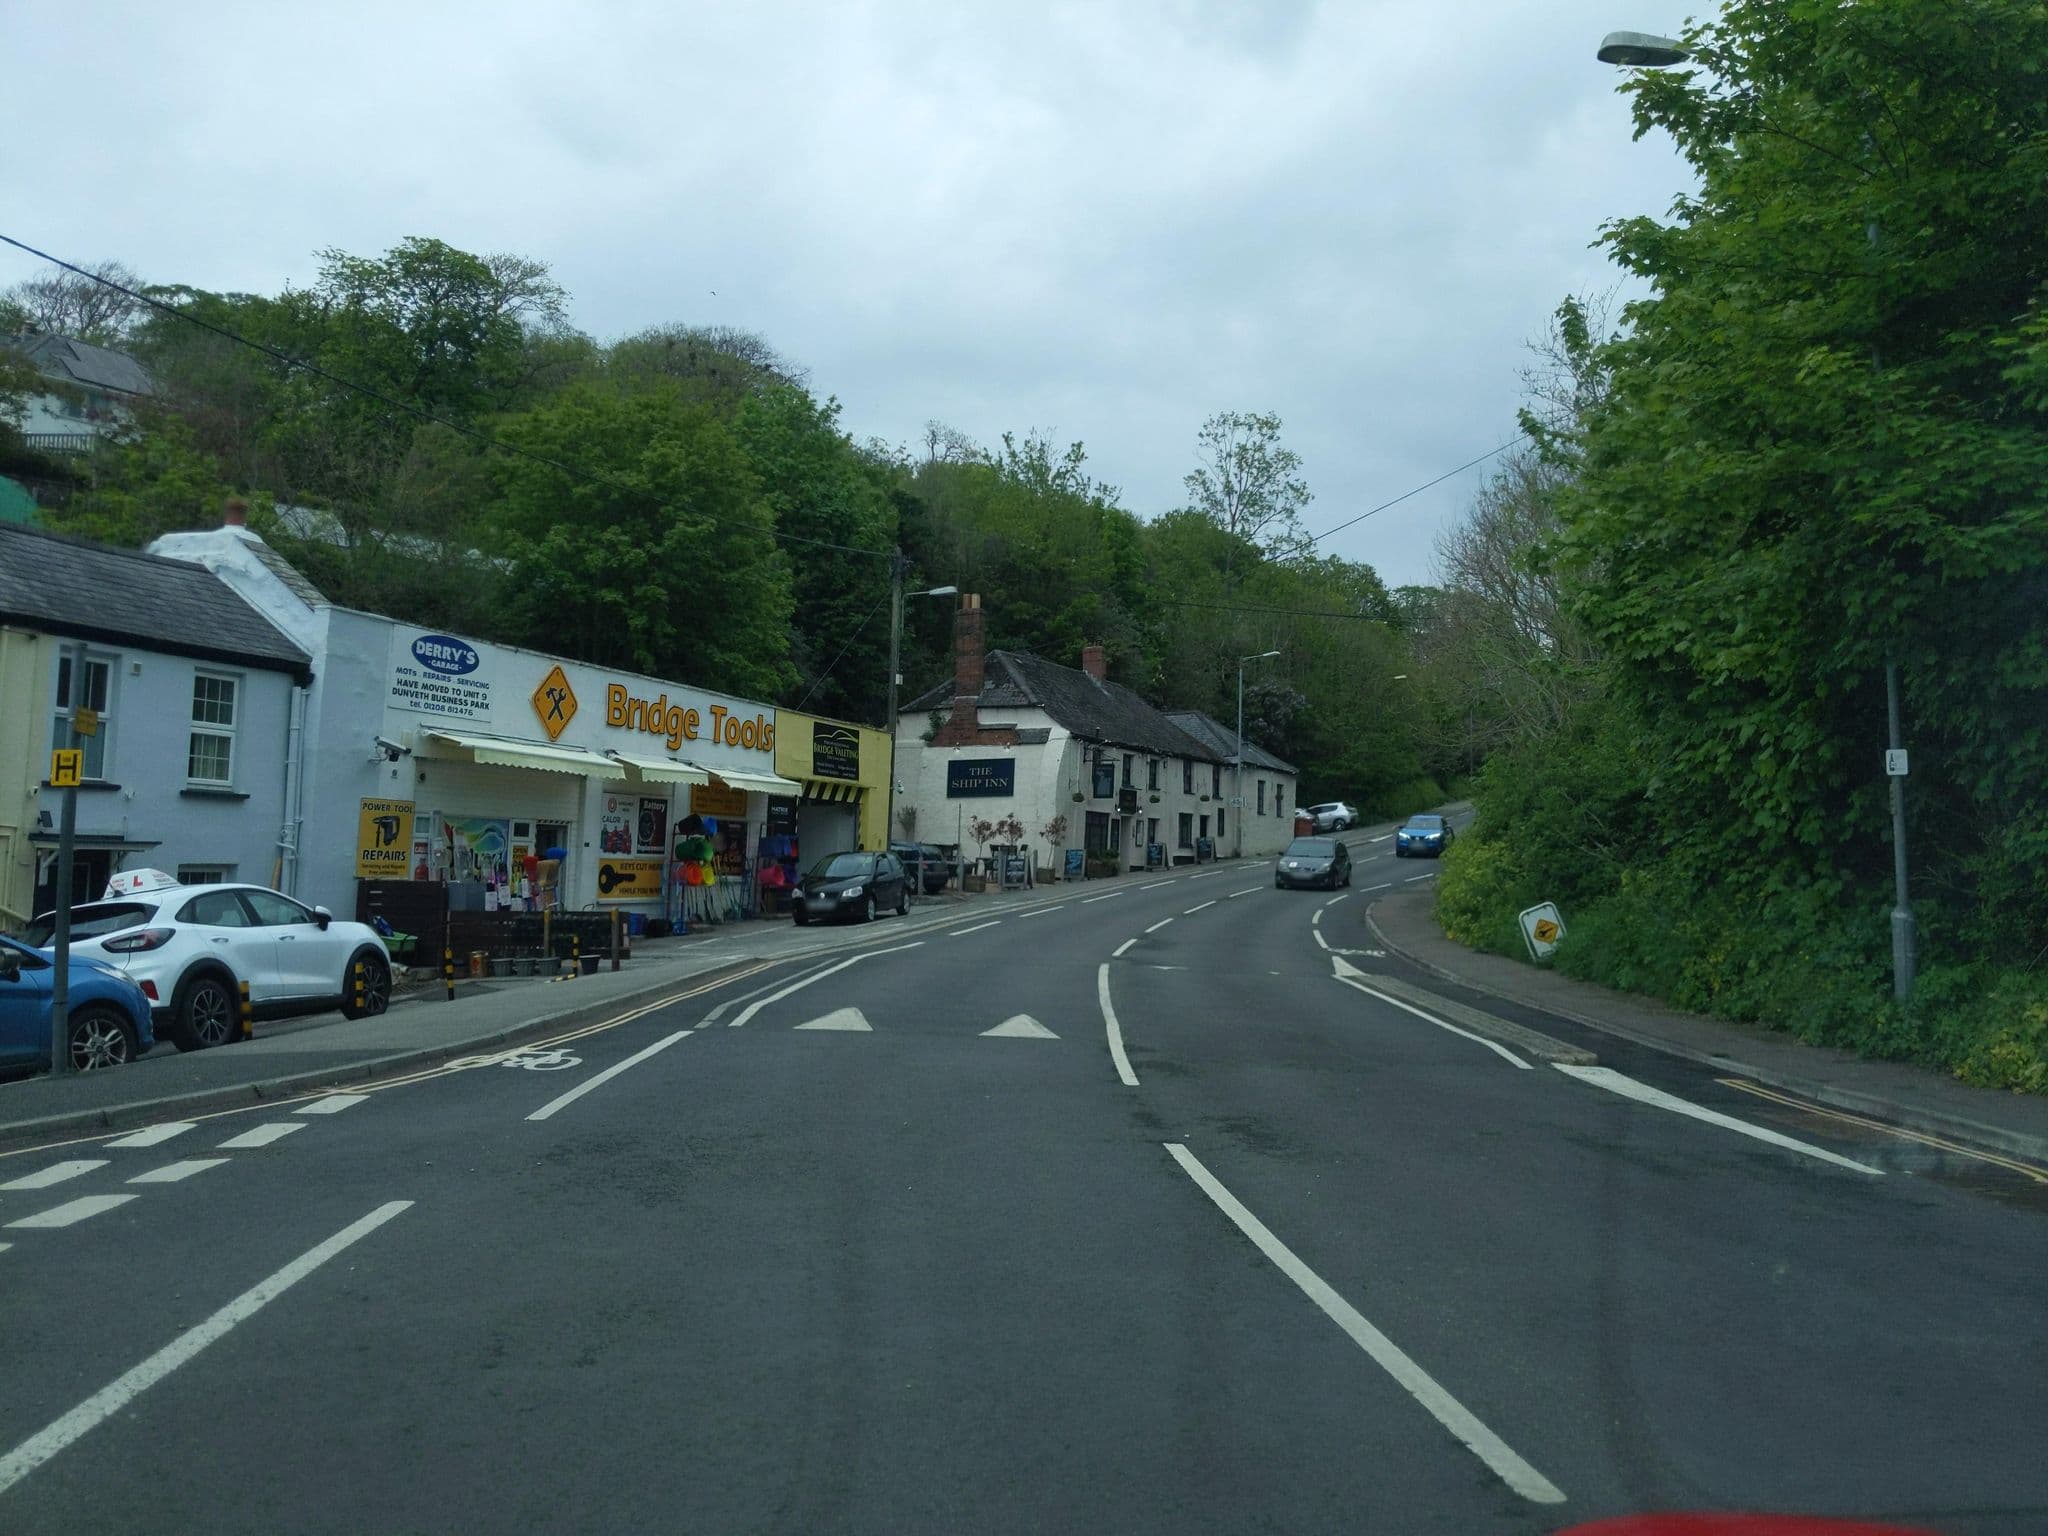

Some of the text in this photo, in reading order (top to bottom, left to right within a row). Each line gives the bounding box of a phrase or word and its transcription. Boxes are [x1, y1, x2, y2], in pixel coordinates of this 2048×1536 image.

[416, 641, 475, 665] DERRY'S
[431, 660, 459, 671] GARAGE
[423, 672, 451, 683] REPAIRS
[457, 678, 490, 690] SERVICING
[396, 678, 487, 701] HAVE MOVED TO UNIT 9
[392, 687, 490, 710] DUNVETH BUSINESS PARK
[607, 683, 774, 752] Bridge Tools
[55, 753, 77, 781] H
[969, 767, 993, 776] THE
[952, 777, 1008, 788] SHIP INN
[362, 803, 413, 813] POWER TOOL
[643, 800, 666, 812] Battery
[362, 850, 407, 861] REPAIRS
